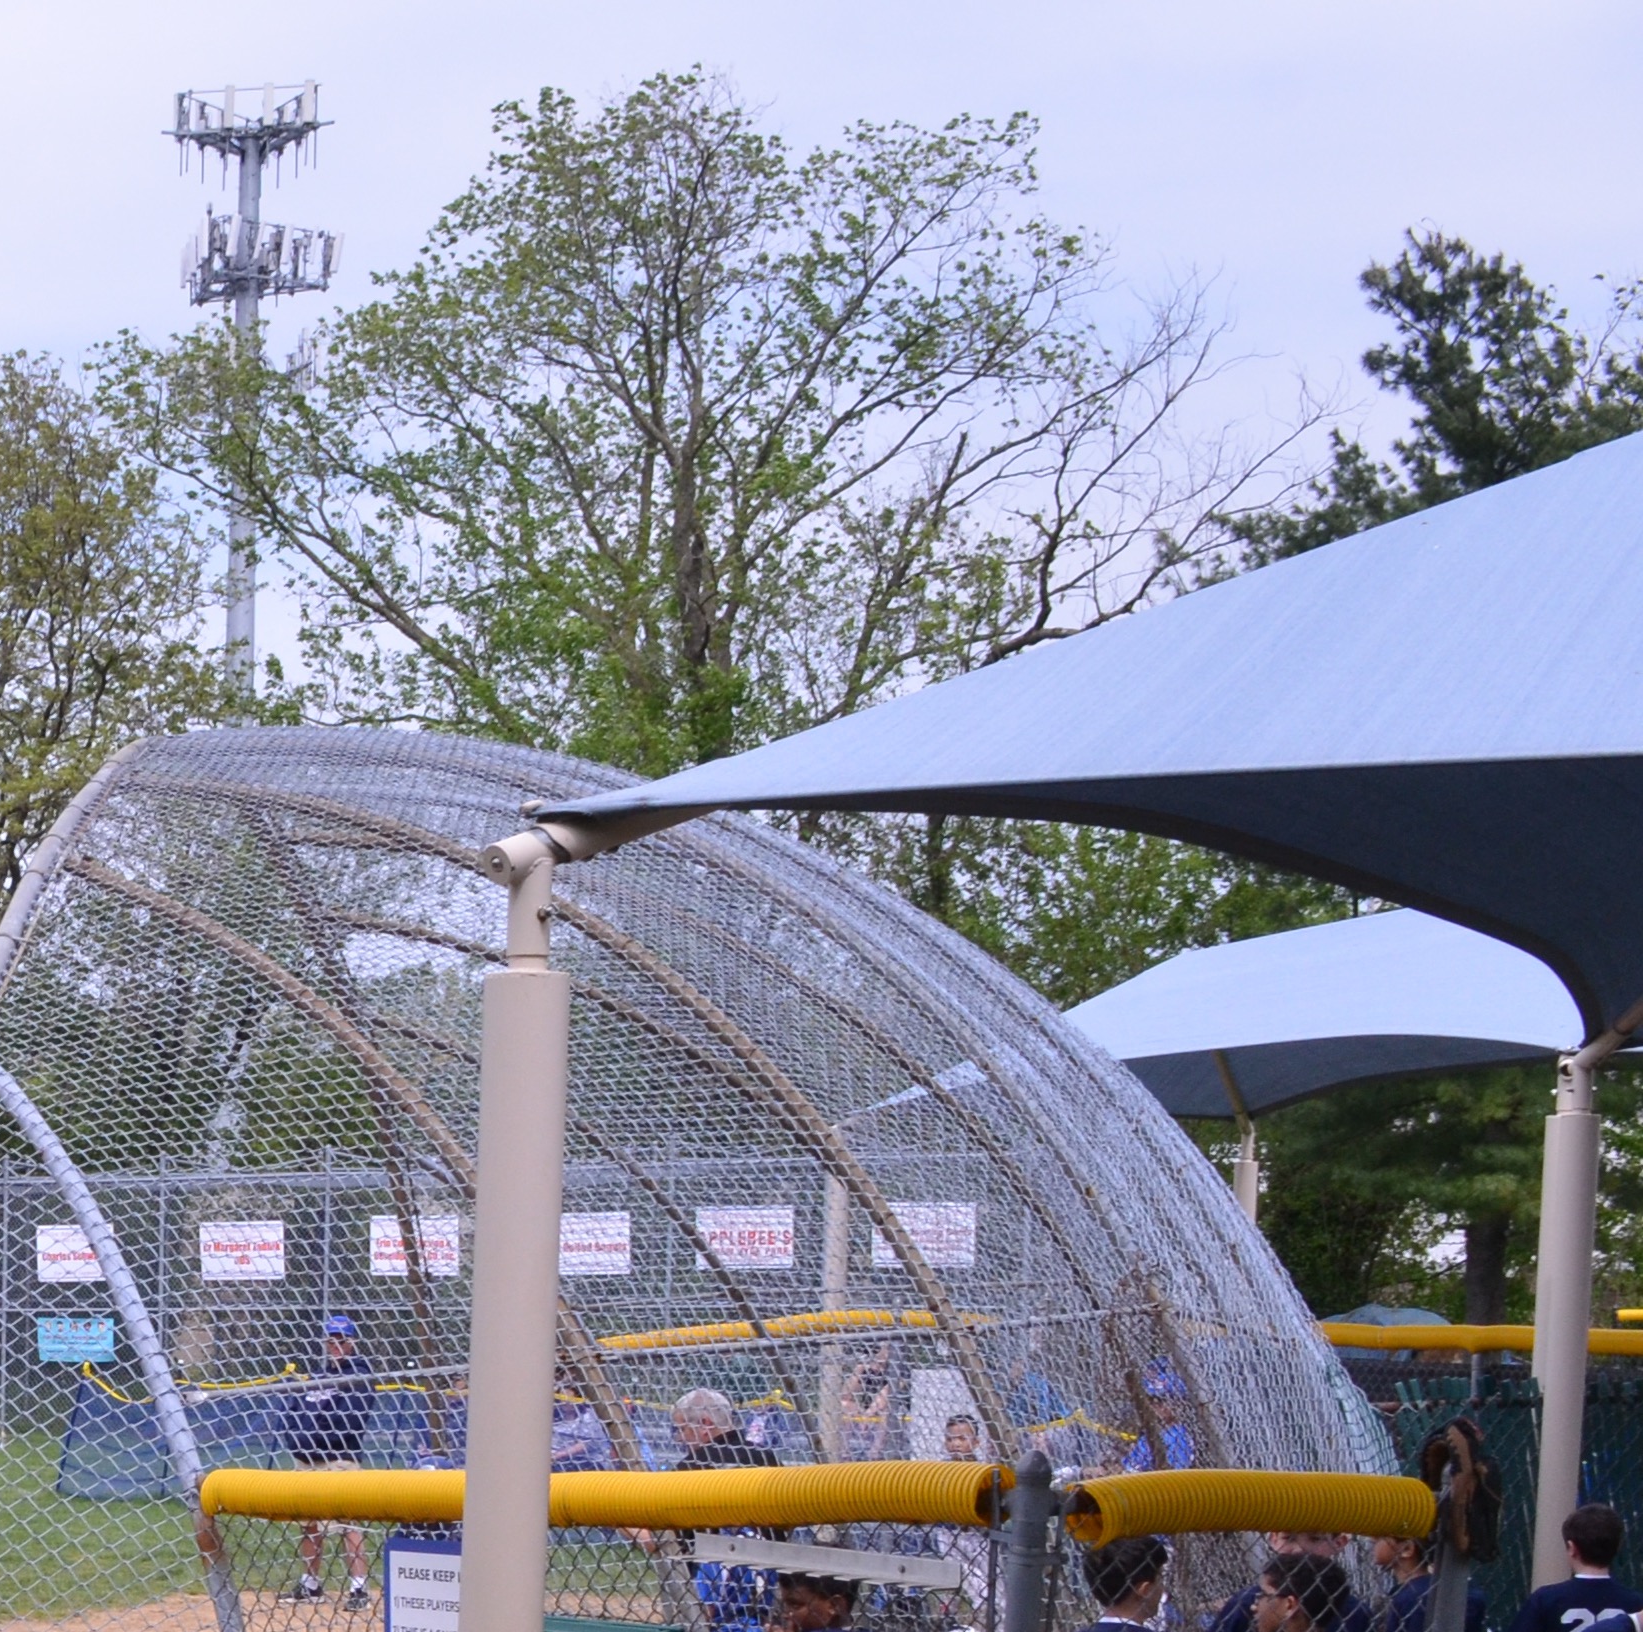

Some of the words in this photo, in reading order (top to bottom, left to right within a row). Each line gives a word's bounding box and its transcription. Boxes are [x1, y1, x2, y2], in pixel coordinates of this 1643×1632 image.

[398, 1567, 430, 1581] PLEASE
[433, 1570, 456, 1582] KEEP
[401, 1596, 425, 1610] THESE
[426, 1599, 460, 1613] PLAYERS
